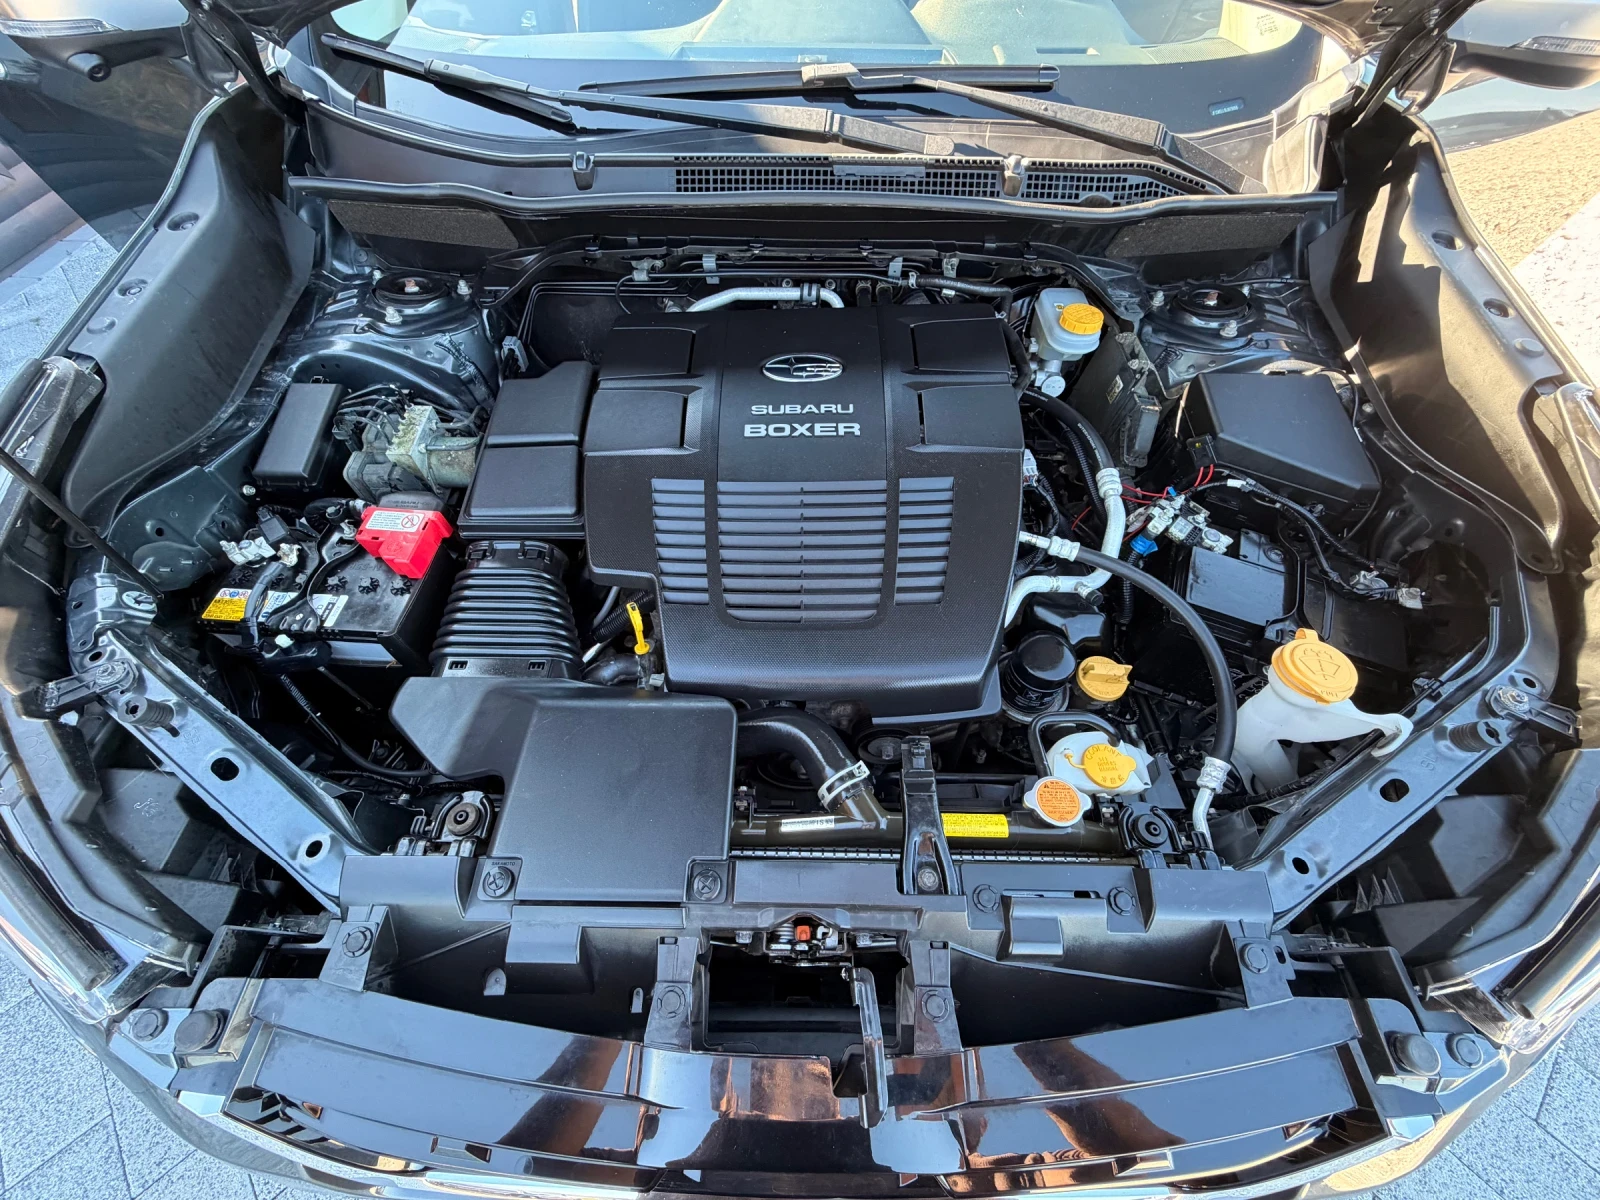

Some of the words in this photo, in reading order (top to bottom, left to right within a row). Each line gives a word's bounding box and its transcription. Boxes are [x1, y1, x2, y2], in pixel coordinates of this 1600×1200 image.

[751, 404, 854, 414] SUBARU
[744, 423, 861, 437] BOXER
[1086, 745, 1122, 760] COOLANT
